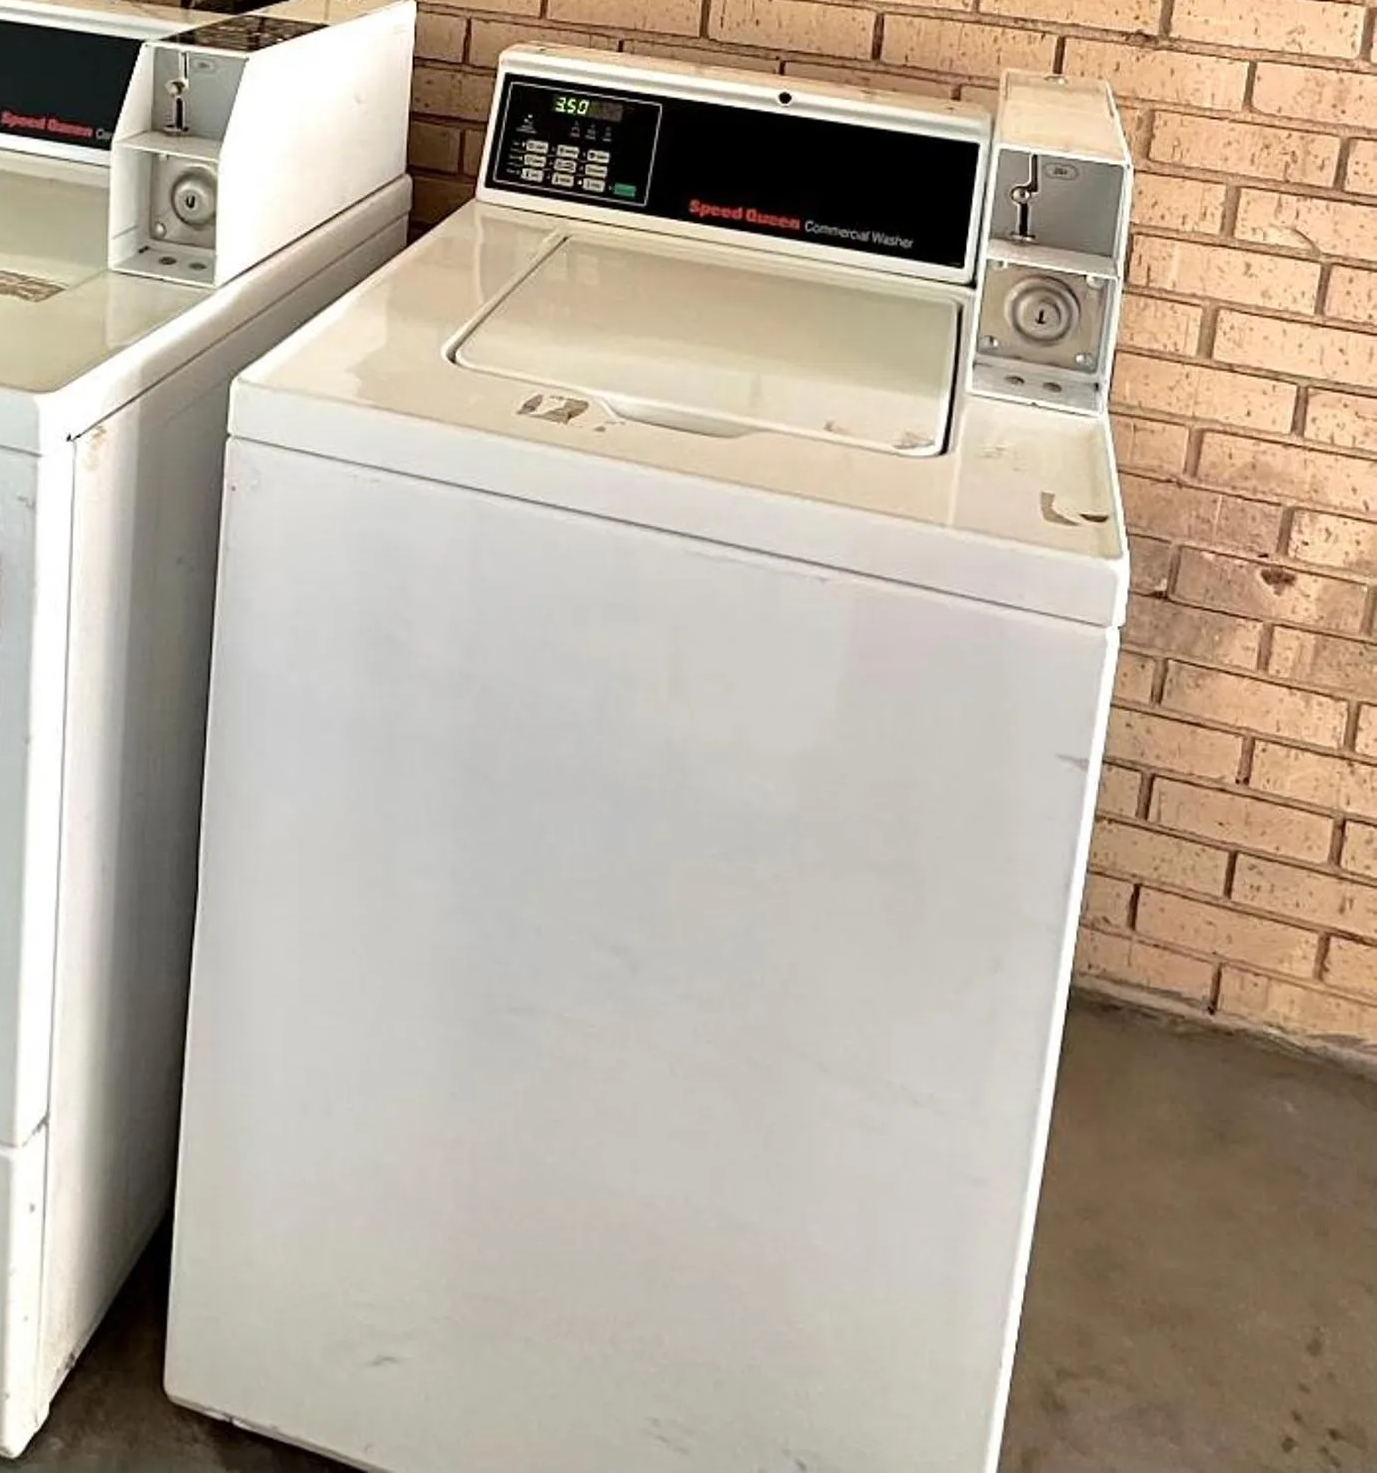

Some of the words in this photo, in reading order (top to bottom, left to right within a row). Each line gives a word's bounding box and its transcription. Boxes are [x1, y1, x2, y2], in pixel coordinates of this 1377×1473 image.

[689, 199, 743, 220] Speed
[745, 208, 800, 230] Queen
[805, 220, 871, 242] Commercial
[871, 231, 914, 249] Washer
